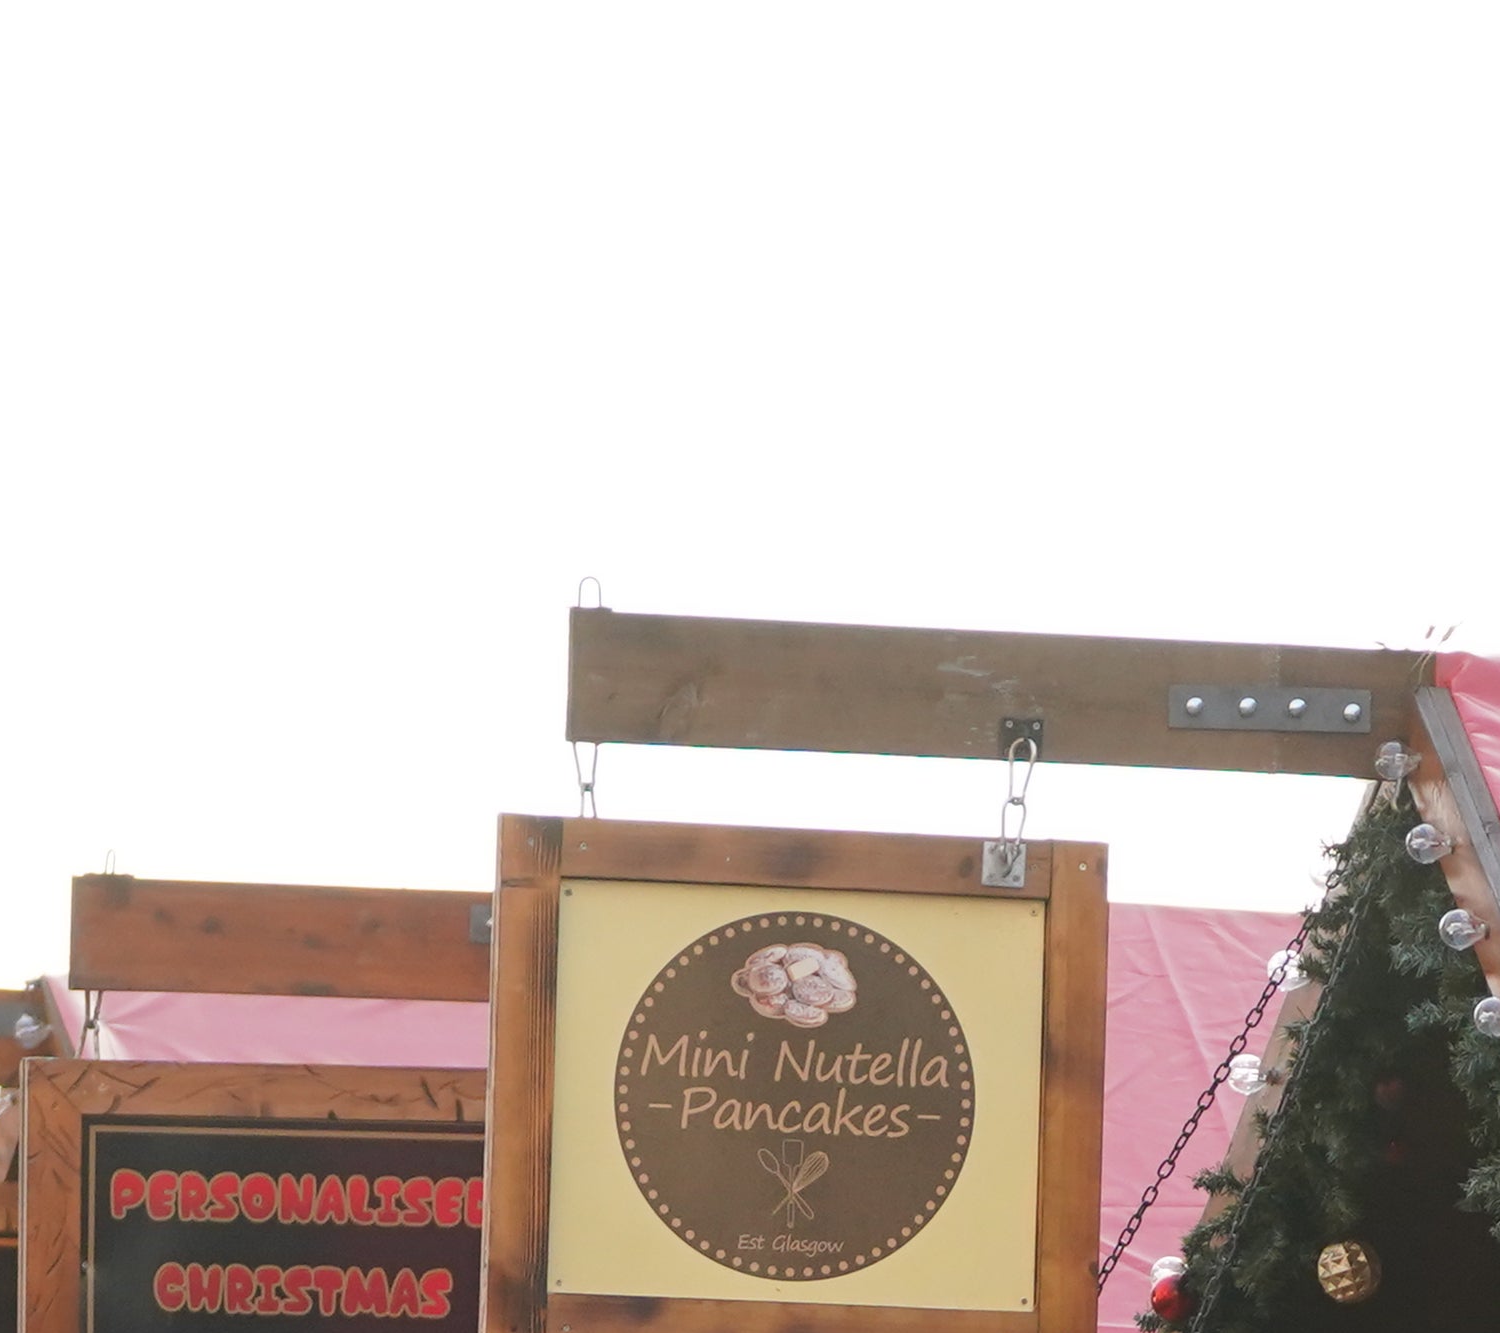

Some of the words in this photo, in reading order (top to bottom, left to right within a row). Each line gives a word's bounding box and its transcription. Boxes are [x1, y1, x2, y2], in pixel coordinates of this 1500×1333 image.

[640, 1030, 753, 1080] Mini
[774, 1036, 950, 1088] Nutella
[737, 1234, 766, 1251] Est
[772, 1234, 845, 1258] Glasgow
[153, 1261, 453, 1320] CHRISTMAS
